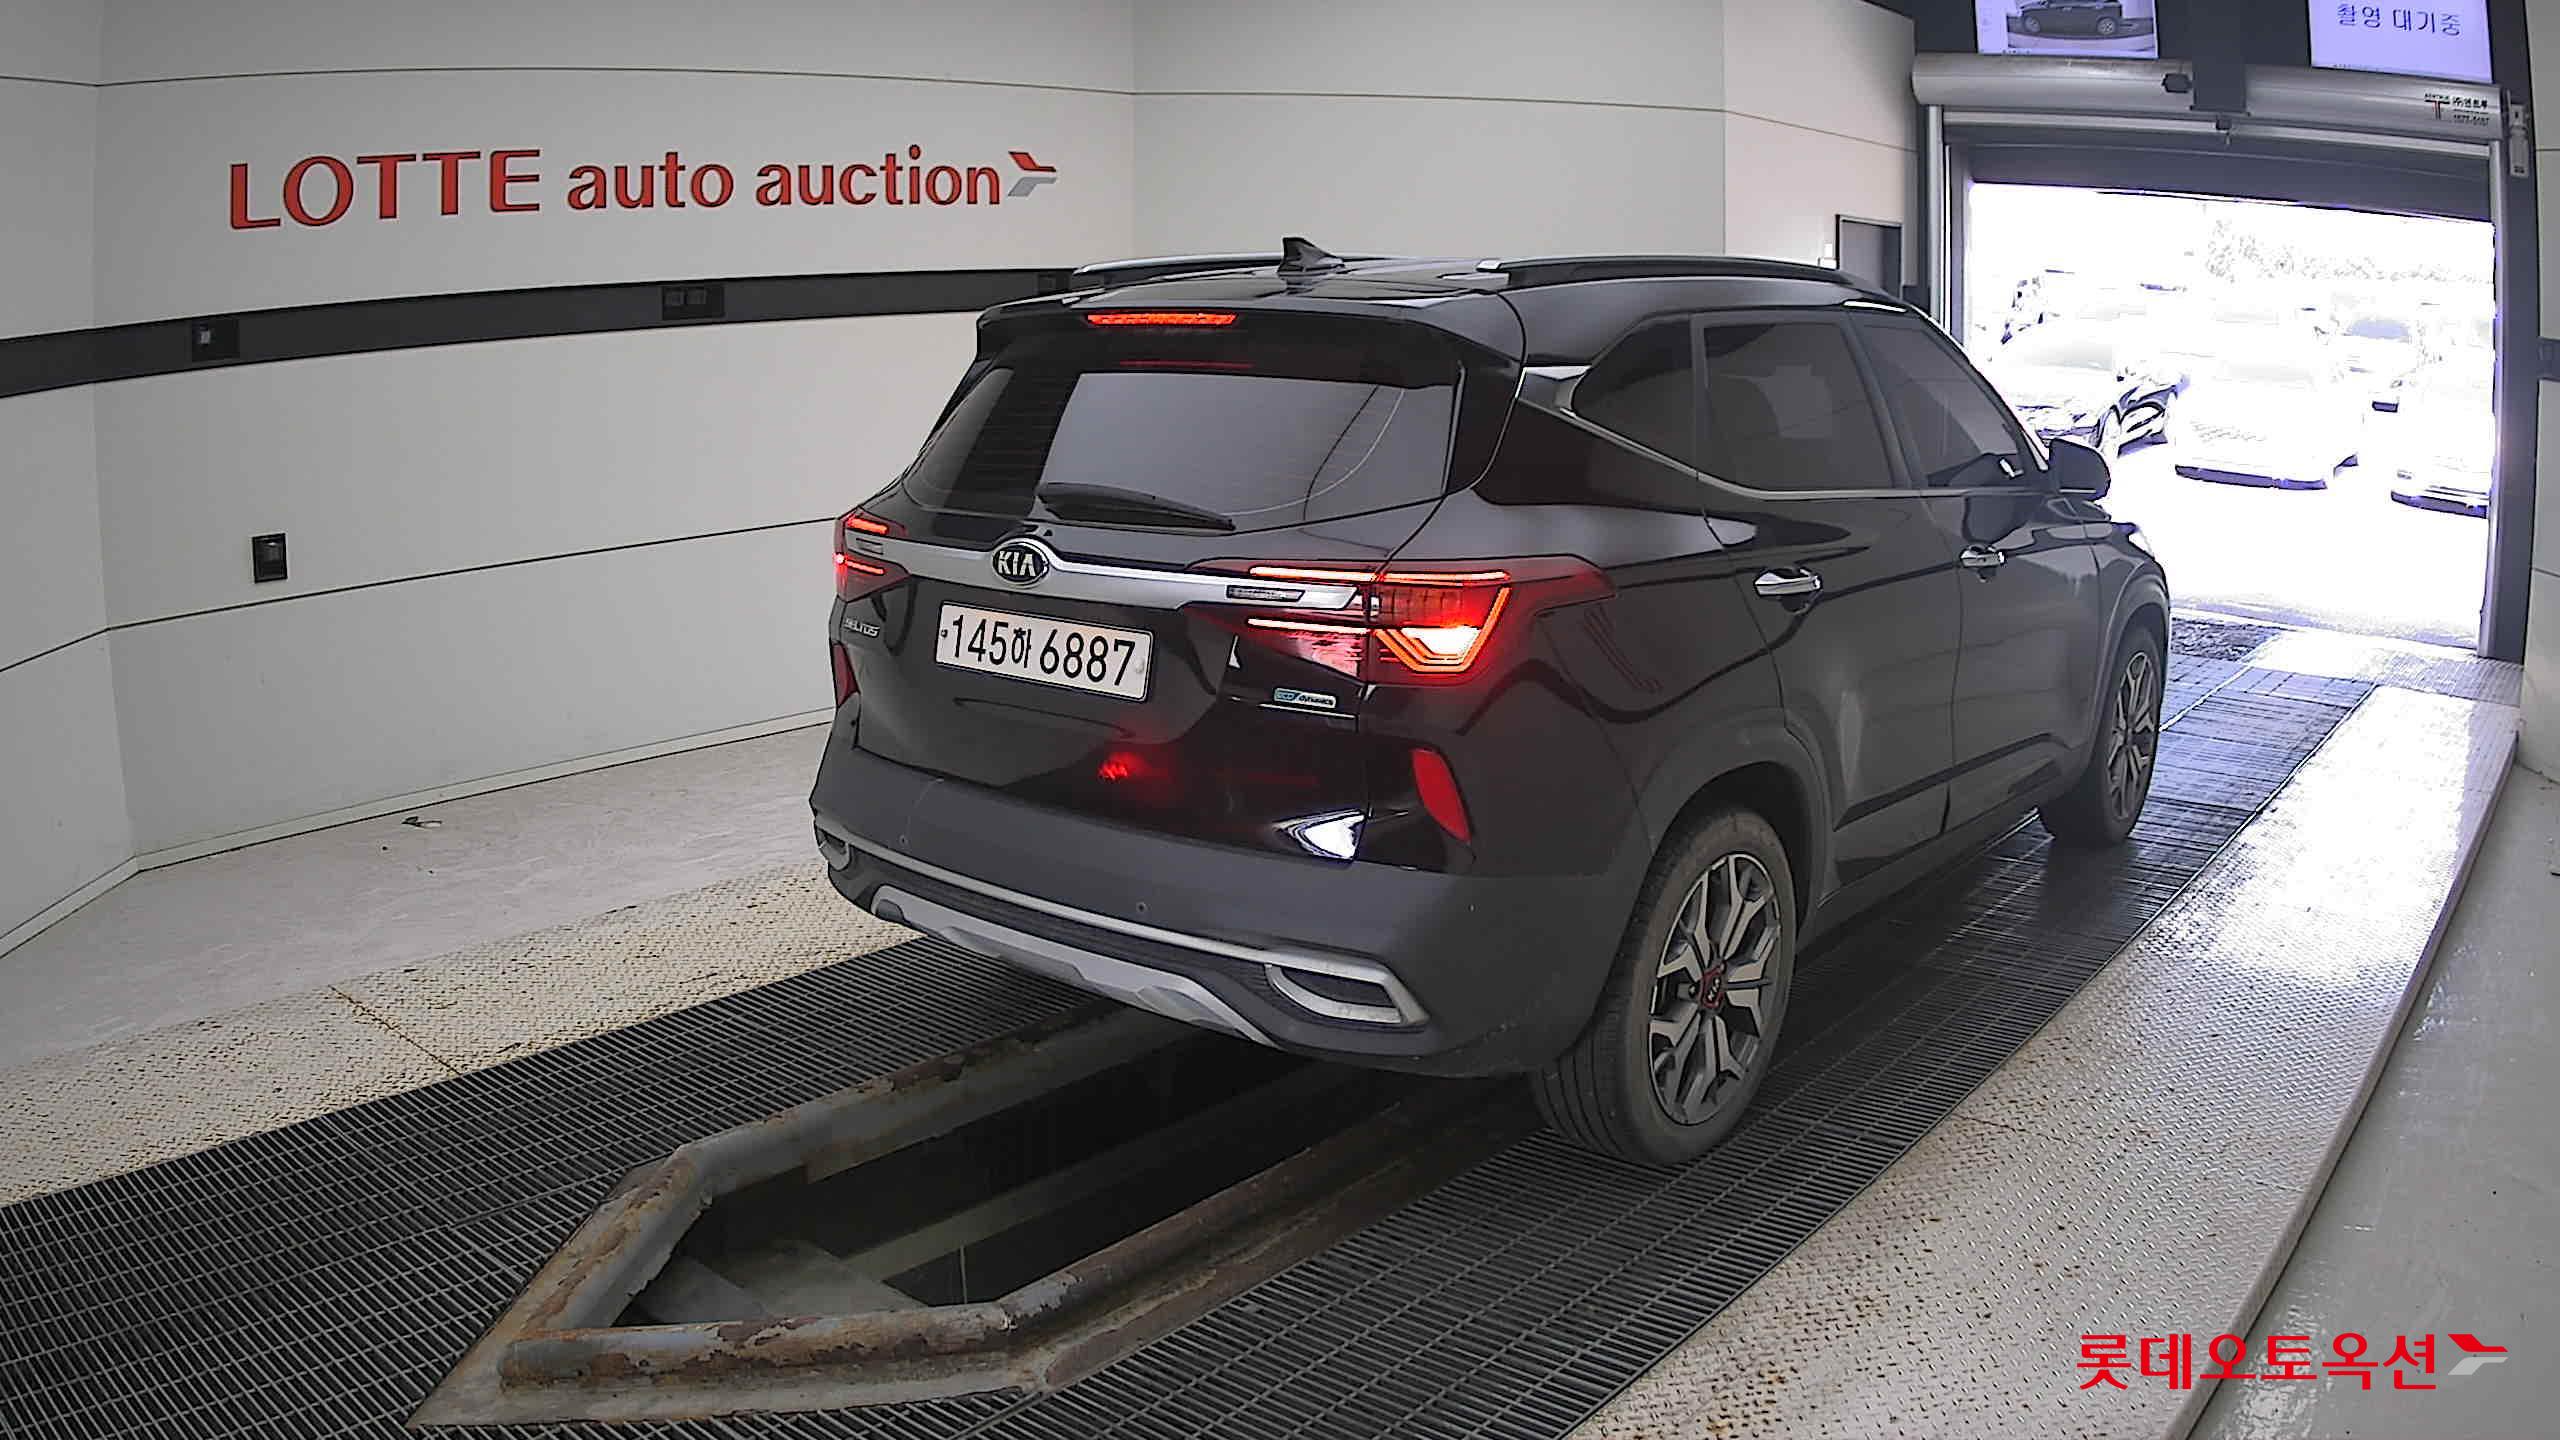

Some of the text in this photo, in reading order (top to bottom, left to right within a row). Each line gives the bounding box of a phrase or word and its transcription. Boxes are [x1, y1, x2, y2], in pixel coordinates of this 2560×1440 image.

[2337, 3, 2462, 37] 촬영 대기중
[229, 144, 1001, 231] LOTTE auto auction
[998, 550, 1037, 577] KIA
[952, 614, 1136, 686] 145하 6887
